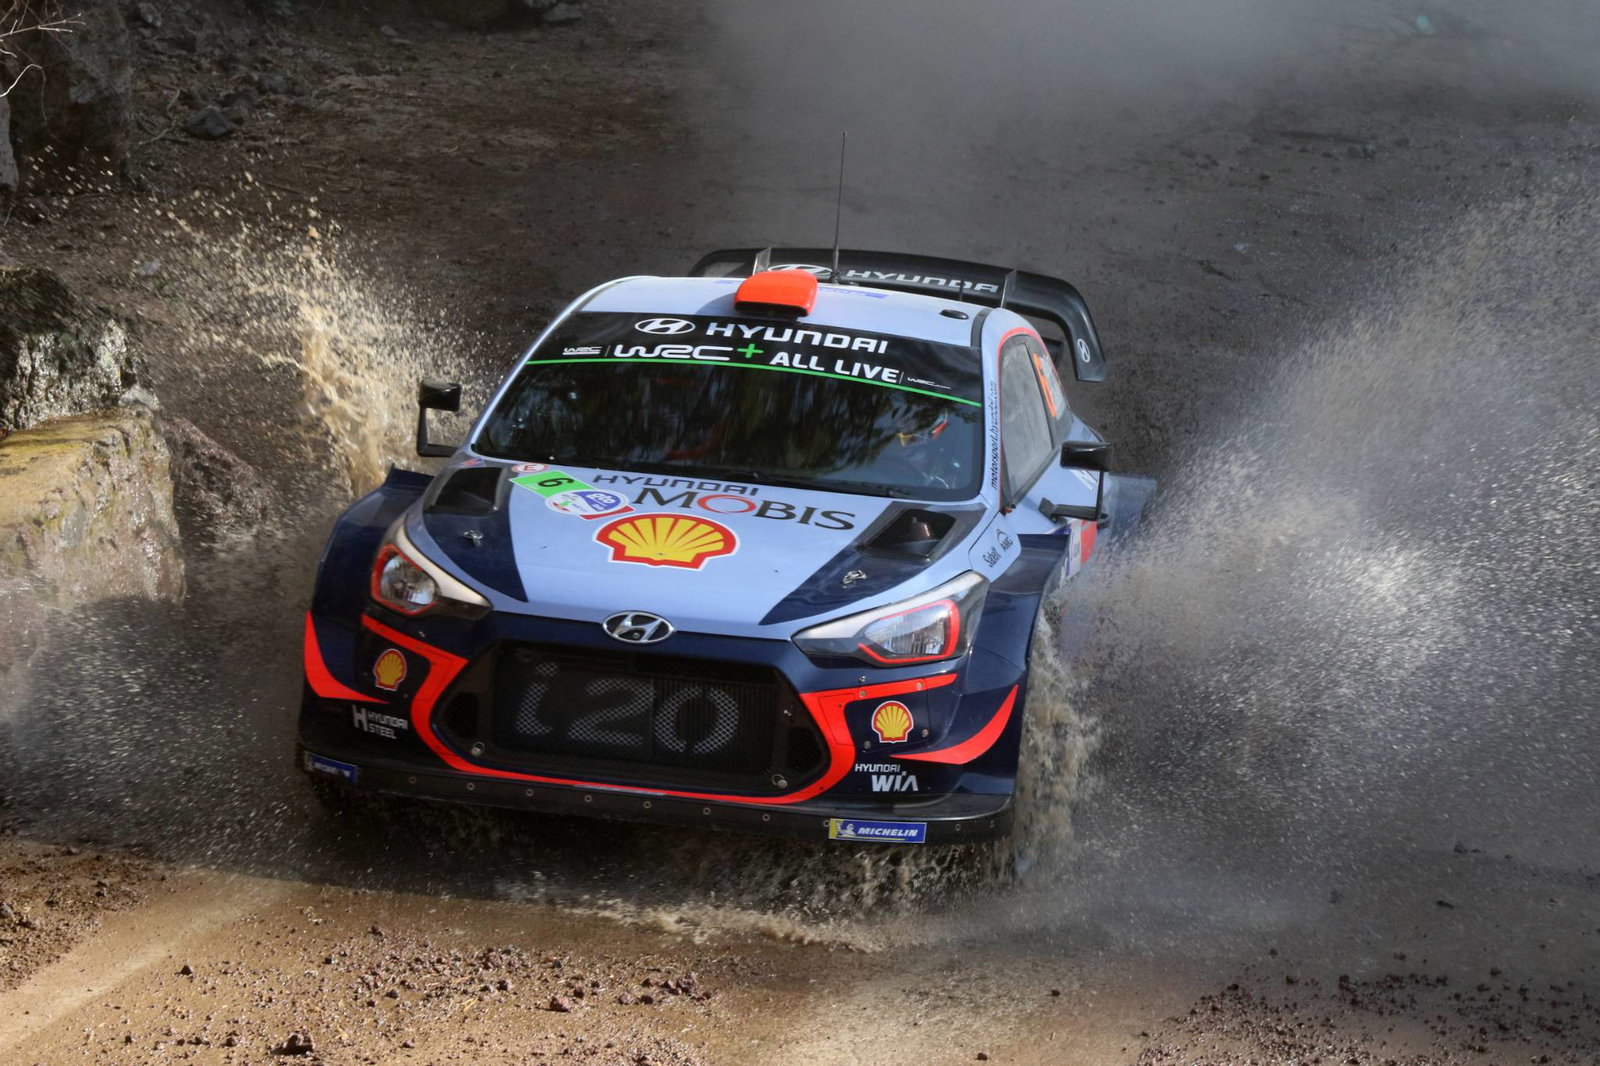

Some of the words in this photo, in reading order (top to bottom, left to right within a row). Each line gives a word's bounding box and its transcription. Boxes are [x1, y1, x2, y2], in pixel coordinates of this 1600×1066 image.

[705, 322, 888, 354] HYUNDAI
[769, 351, 824, 371] ALL
[834, 359, 900, 384] LIVE
[592, 474, 759, 496] HYUNDAI
[633, 487, 856, 531] MOBIS
[515, 661, 739, 753] i20
[367, 711, 409, 731] HYUNDAI
[368, 723, 397, 740] STEEL
[855, 763, 901, 773] HYUNDAI
[871, 770, 919, 792] WIA
[857, 827, 919, 837] MICHELIN
